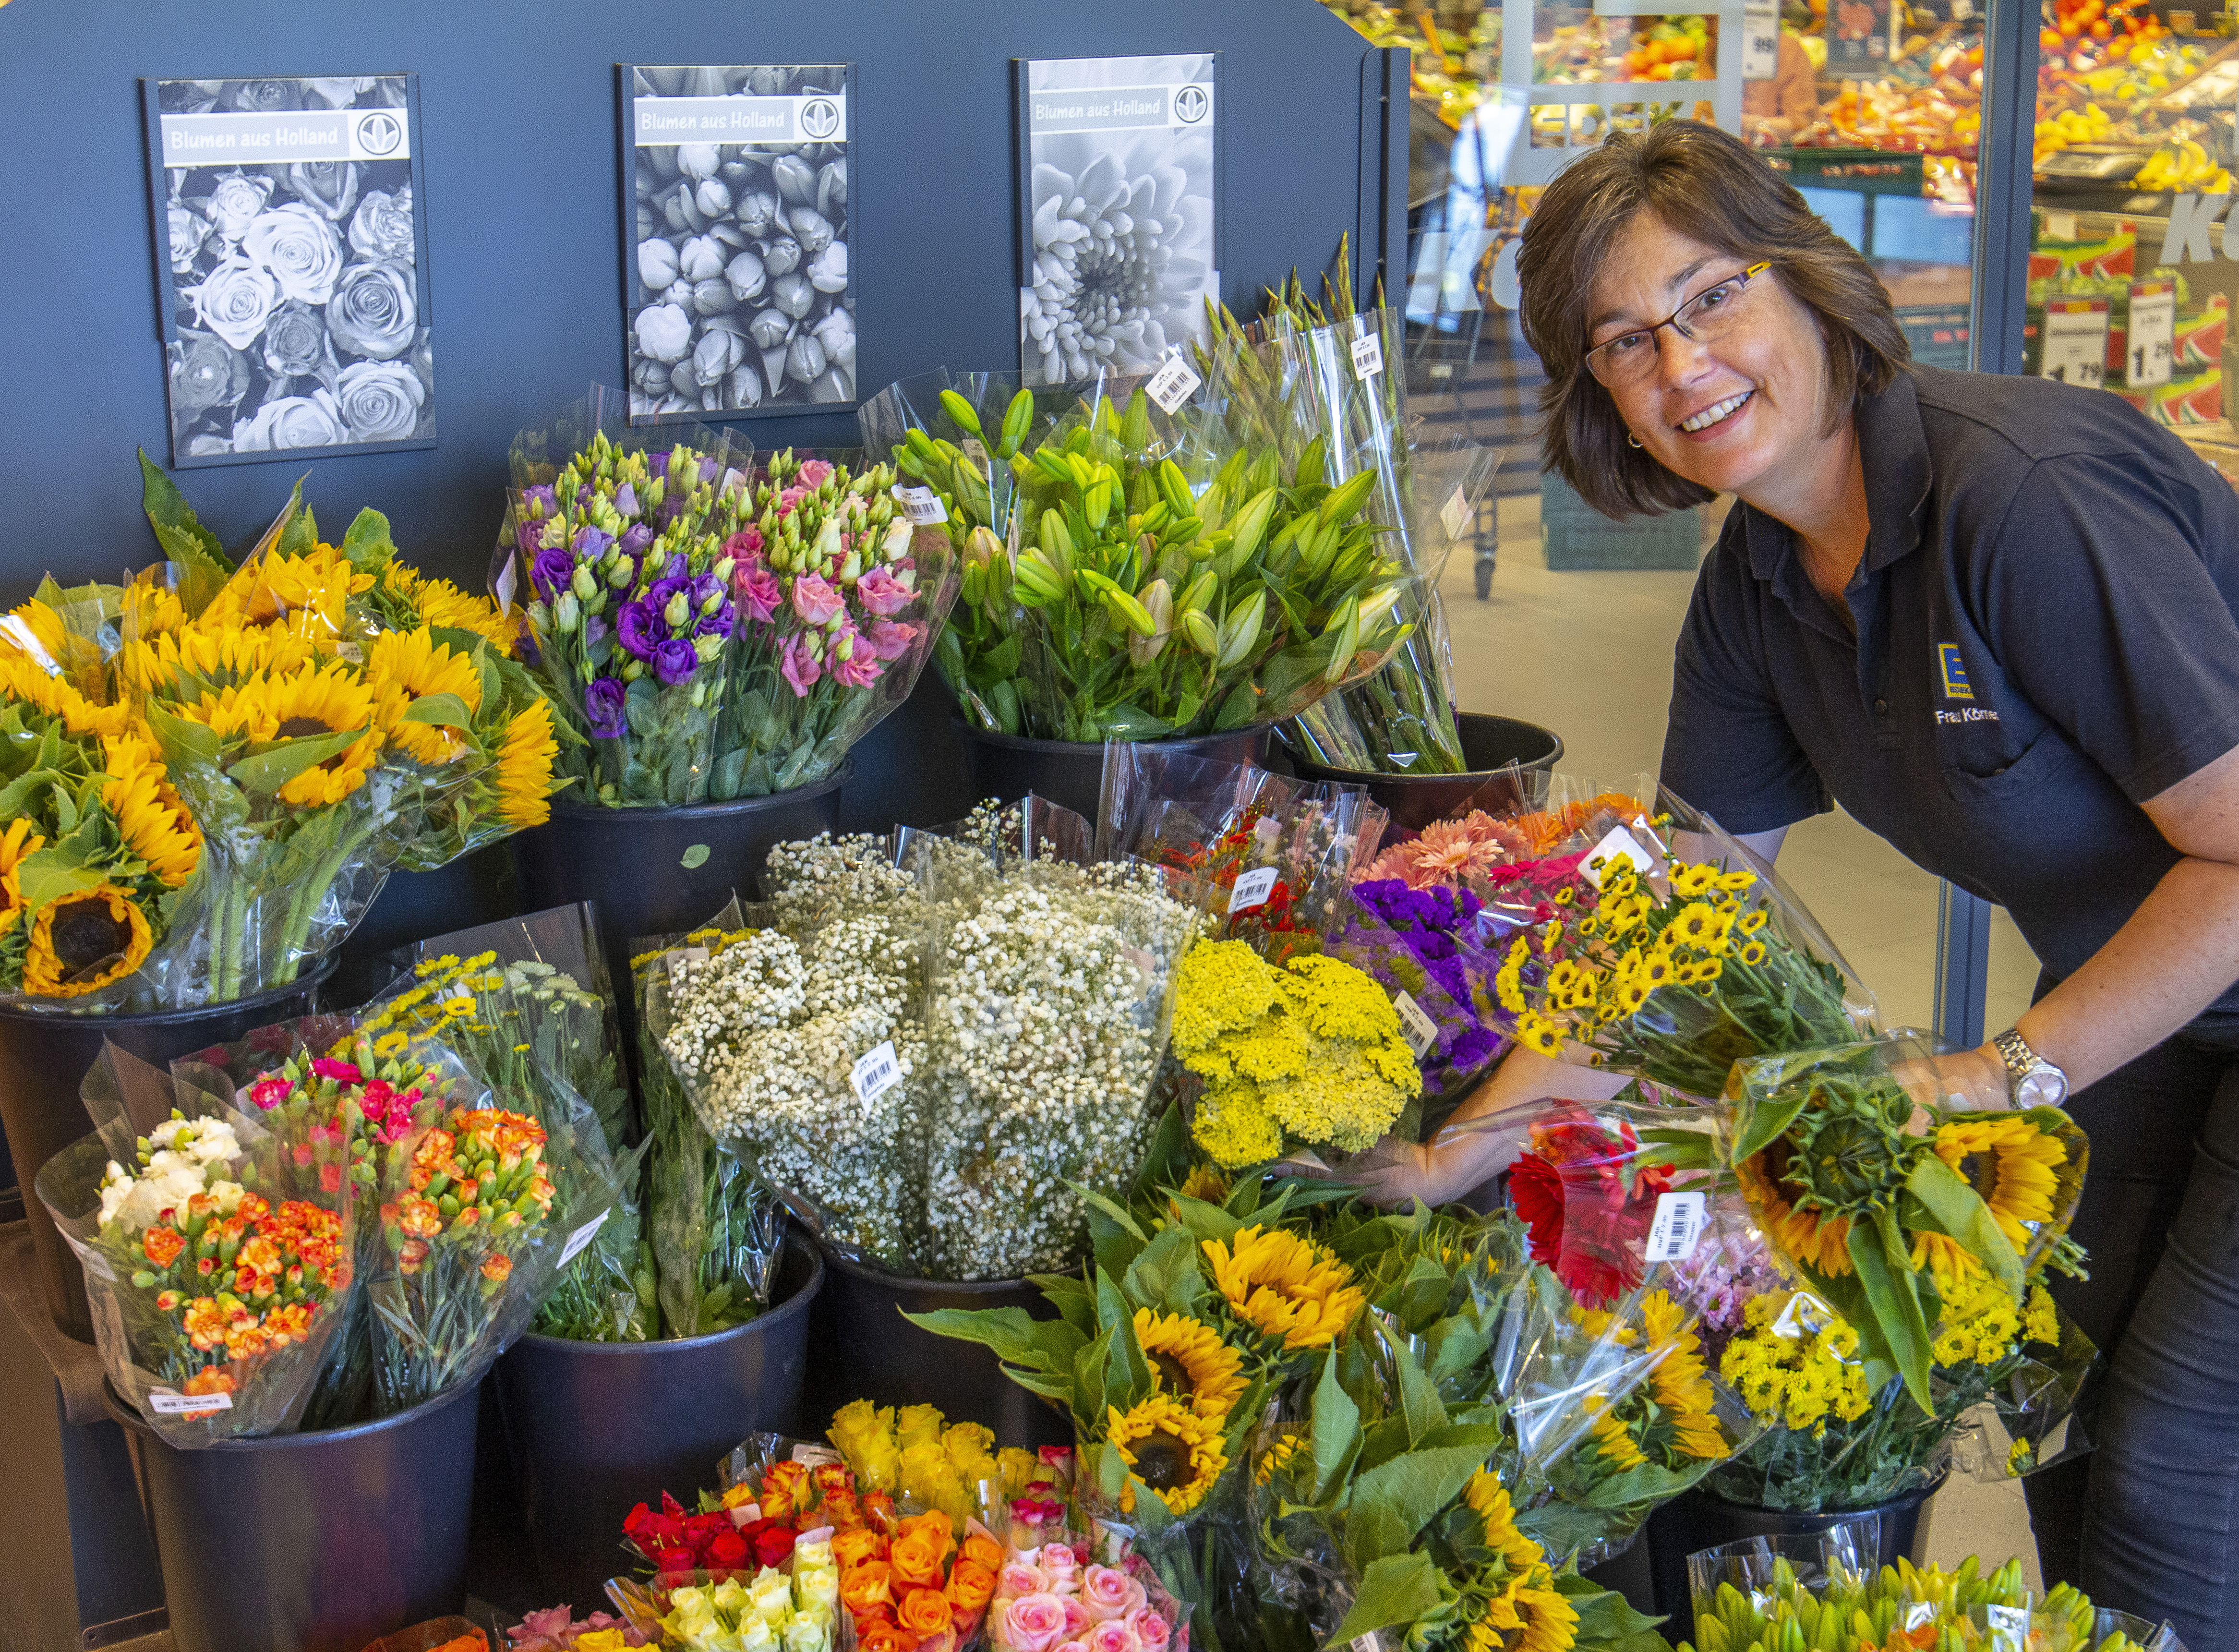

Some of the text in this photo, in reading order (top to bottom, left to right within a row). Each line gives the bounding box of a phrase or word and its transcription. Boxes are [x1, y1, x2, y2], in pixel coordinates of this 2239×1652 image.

[1035, 99, 1160, 120] Blumen aus Holland
[641, 111, 784, 130] Blumen aus Holland
[170, 127, 337, 150] Blumen aus Holland
